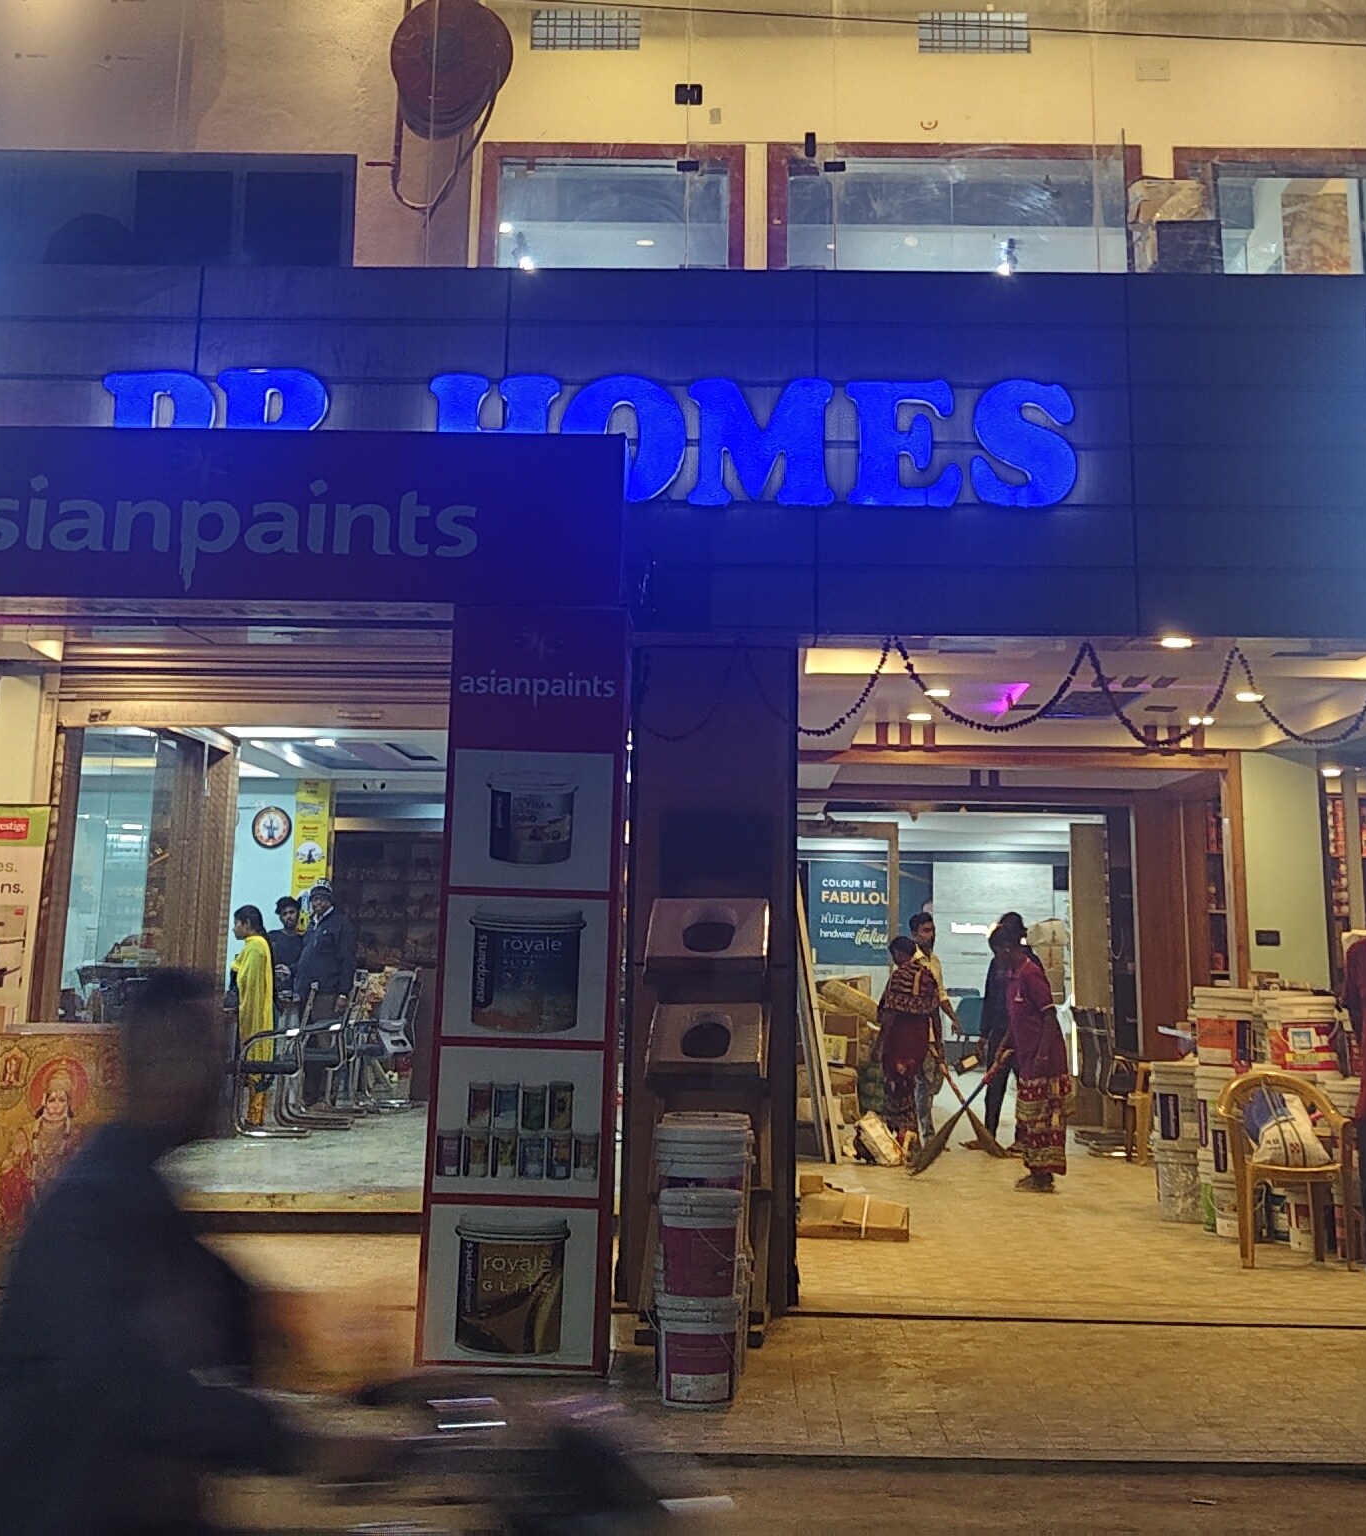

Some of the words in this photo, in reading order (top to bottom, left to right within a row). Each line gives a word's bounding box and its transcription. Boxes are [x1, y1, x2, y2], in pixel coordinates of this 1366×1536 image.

[458, 669, 616, 707] asianpaints
[822, 878, 862, 888] COLOUR
[862, 879, 877, 889] ME
